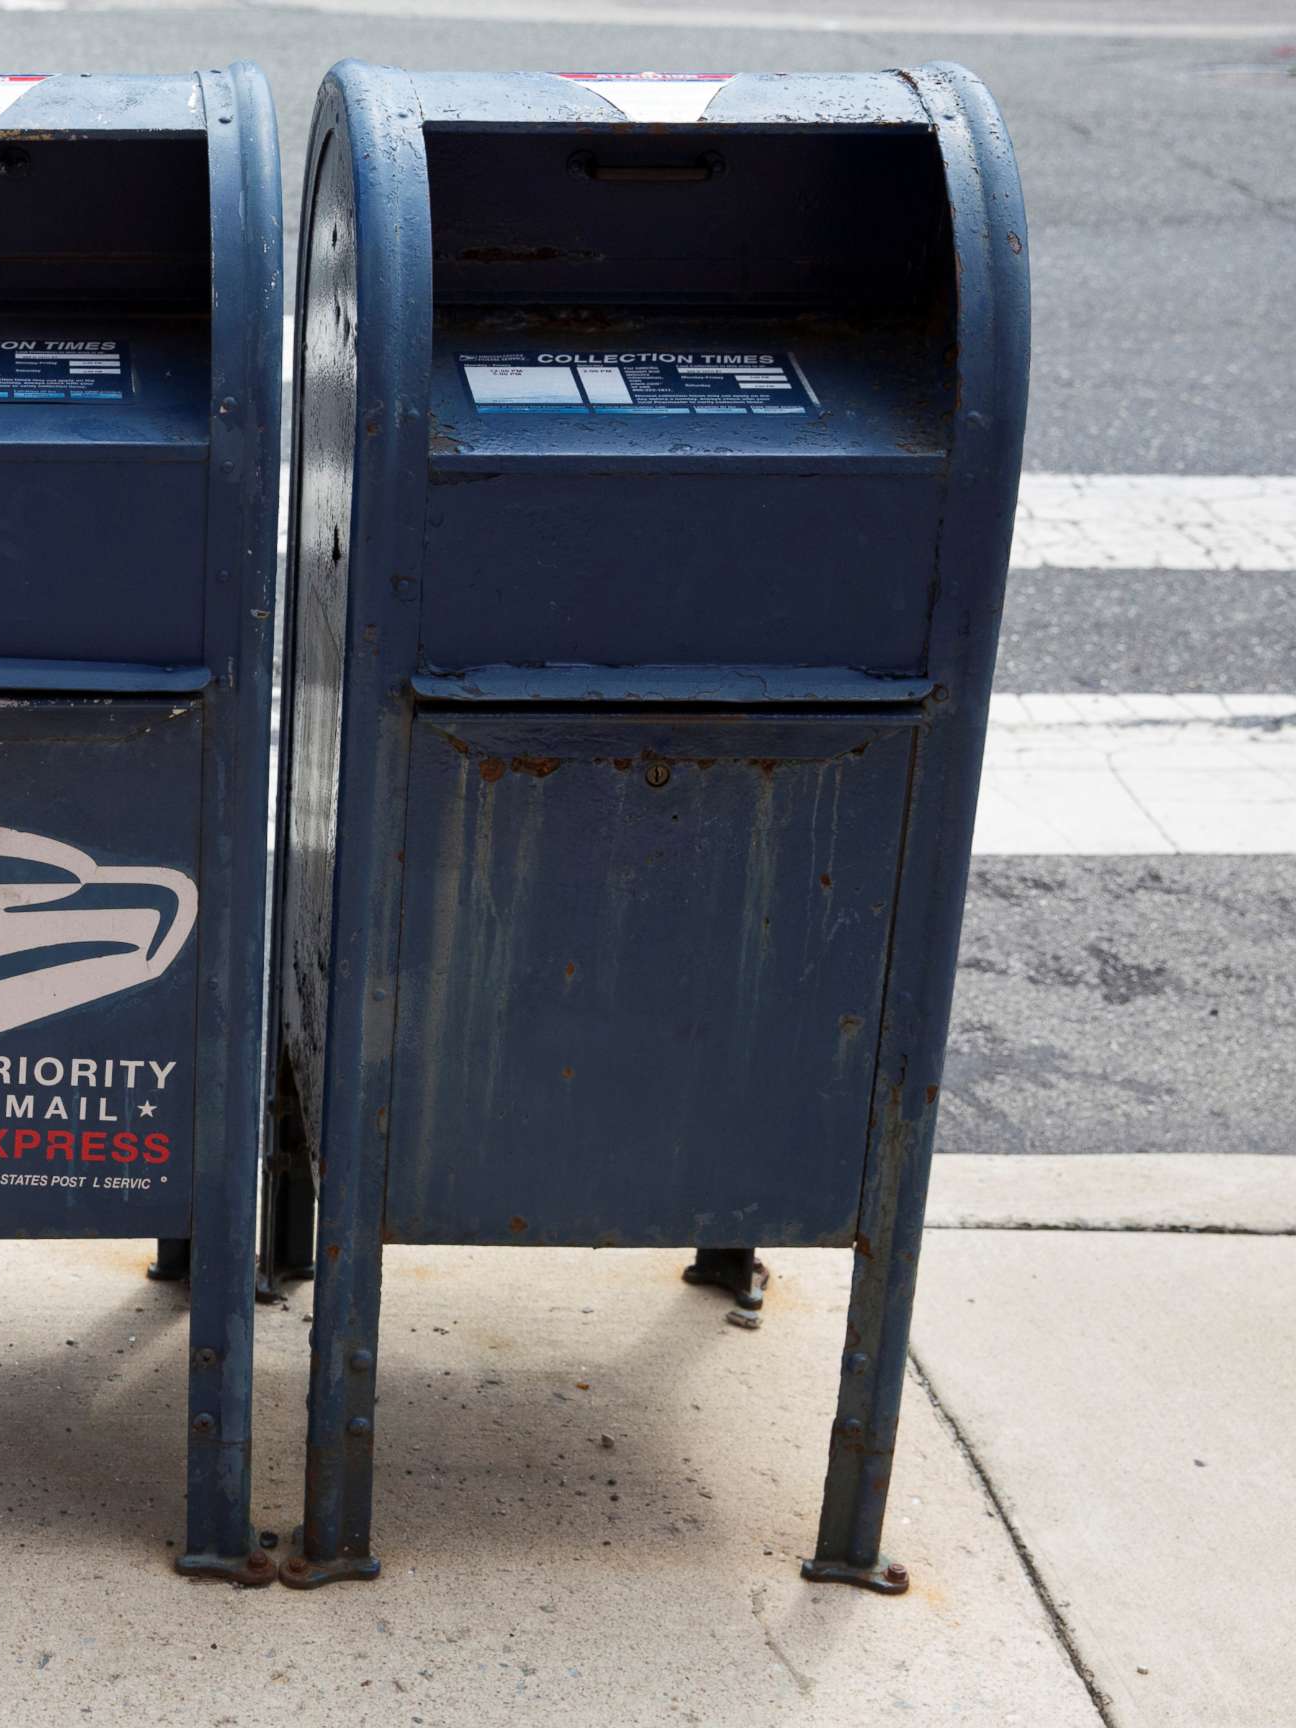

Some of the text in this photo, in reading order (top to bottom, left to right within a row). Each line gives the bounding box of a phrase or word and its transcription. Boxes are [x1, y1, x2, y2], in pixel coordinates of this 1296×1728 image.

[44, 341, 117, 351] TIMES
[537, 352, 694, 364] COLLECTION
[701, 354, 775, 364] TIMES
[5, 1094, 118, 1122] MAIL
[0, 1174, 48, 1187] STATES
[50, 1175, 101, 1189] POSTL
